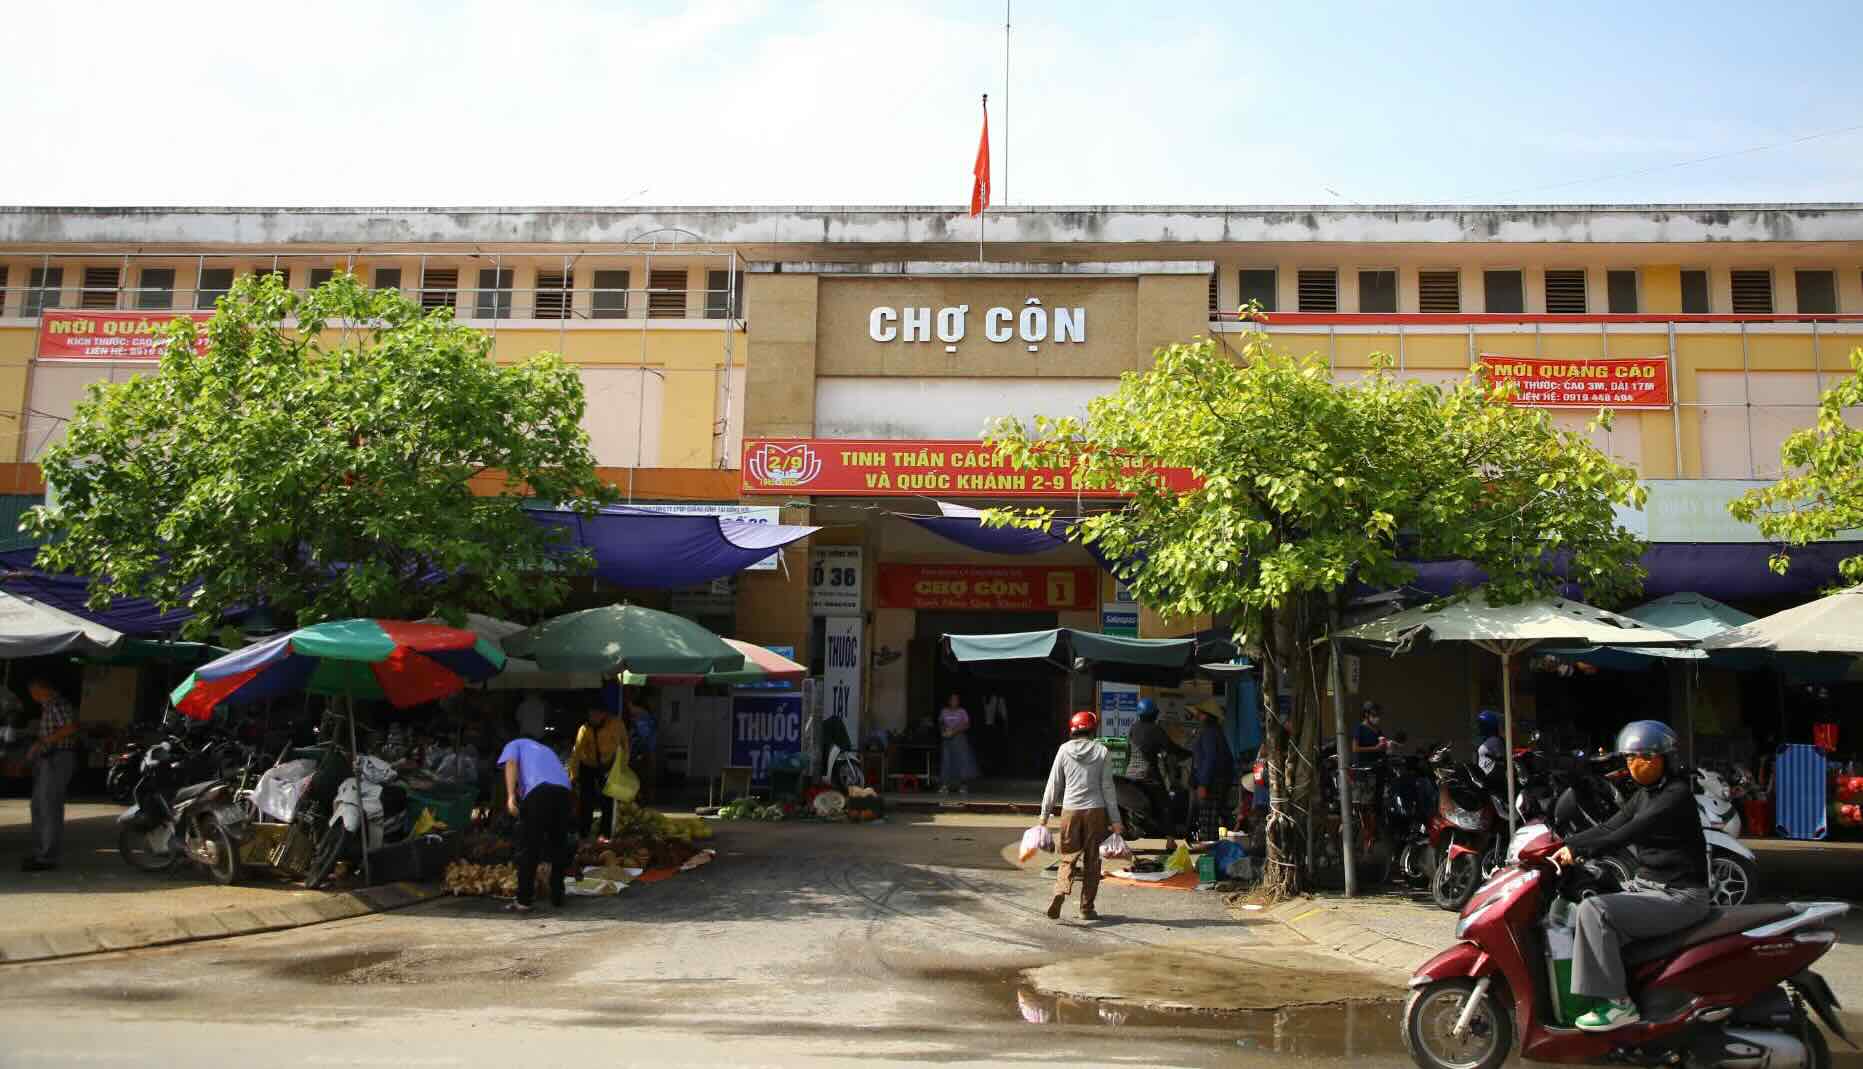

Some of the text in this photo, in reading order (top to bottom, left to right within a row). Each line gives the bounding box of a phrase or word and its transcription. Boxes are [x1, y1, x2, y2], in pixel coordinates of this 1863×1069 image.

[49, 317, 170, 336] MỜI QUẢN
[869, 297, 1085, 353] CHỢ CỘN
[1494, 361, 1656, 379] MỜI QUẢNG CÁO
[1563, 382, 1585, 390] CAO
[768, 455, 803, 470] 2/9
[840, 451, 886, 466] TINH
[892, 447, 945, 467] THẦN
[951, 449, 1003, 468] CÁCH
[865, 471, 891, 489] VÀ
[896, 469, 951, 490] QUỐC
[957, 471, 1026, 489] KHÁNH
[1031, 476, 1065, 489] 2-9
[831, 567, 856, 587] 36
[827, 624, 858, 668] THUỐC
[736, 702, 800, 743] THUỐC
